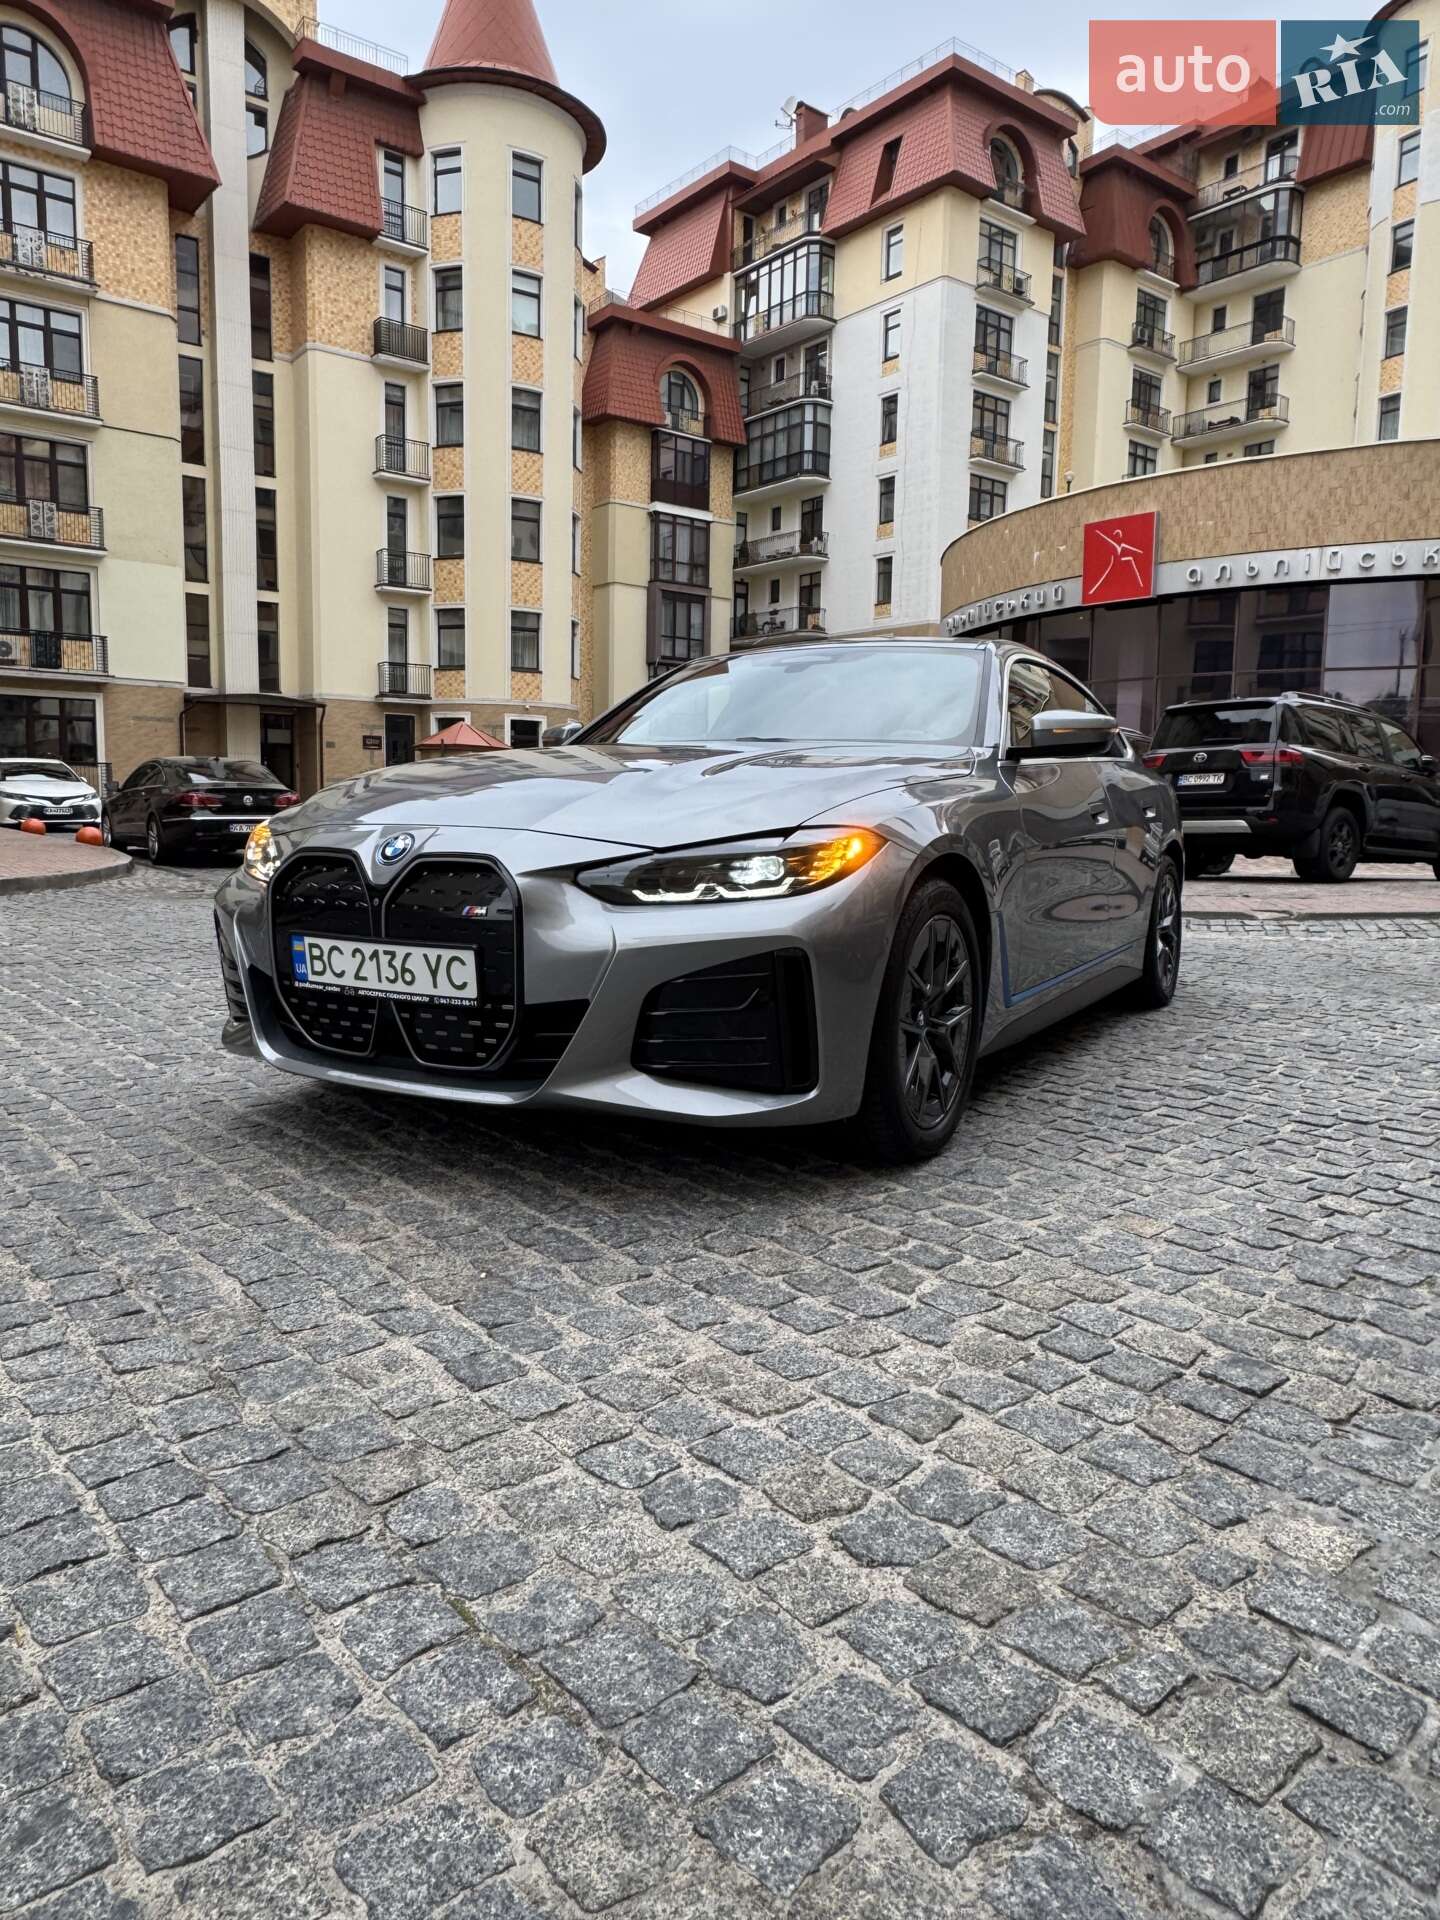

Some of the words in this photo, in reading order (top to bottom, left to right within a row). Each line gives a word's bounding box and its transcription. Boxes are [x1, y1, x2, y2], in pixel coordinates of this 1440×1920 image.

[295, 963, 307, 975] UA
[308, 942, 347, 979] BC
[351, 947, 416, 987] 2136
[422, 952, 469, 991] YC
